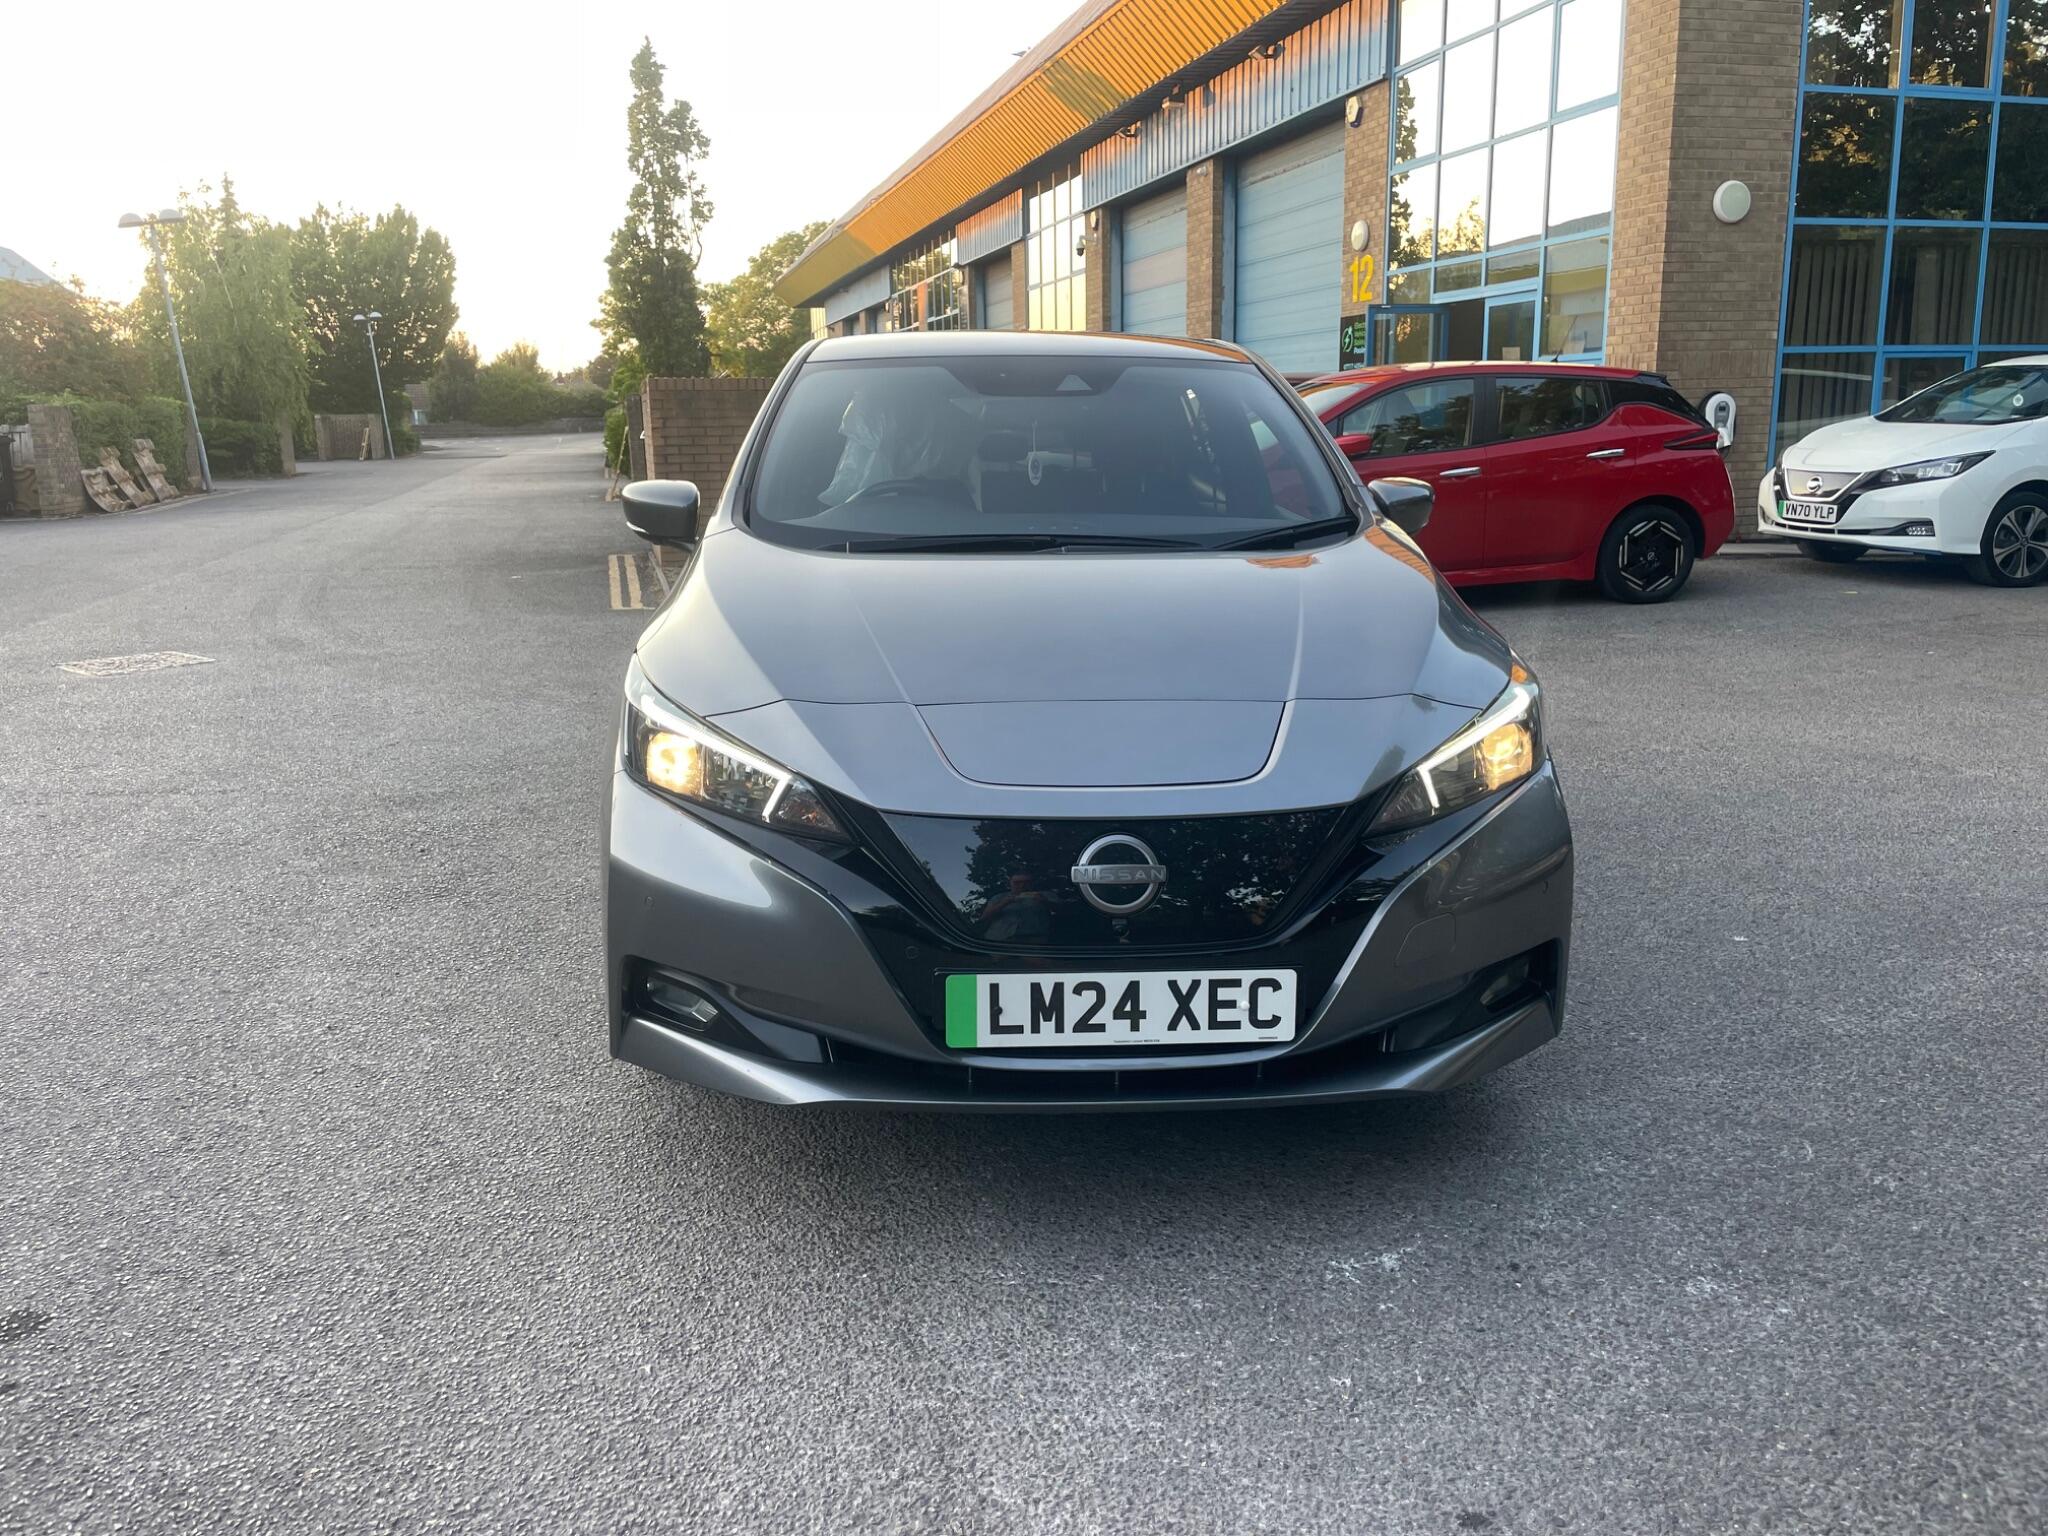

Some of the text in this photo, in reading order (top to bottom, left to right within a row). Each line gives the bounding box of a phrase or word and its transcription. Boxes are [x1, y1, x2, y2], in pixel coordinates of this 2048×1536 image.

[1350, 254, 1374, 303] 12
[1785, 502, 1835, 519] VN70 YLP
[1073, 867, 1166, 882] NISSAN
[988, 977, 1283, 1035] LM24 XEC
